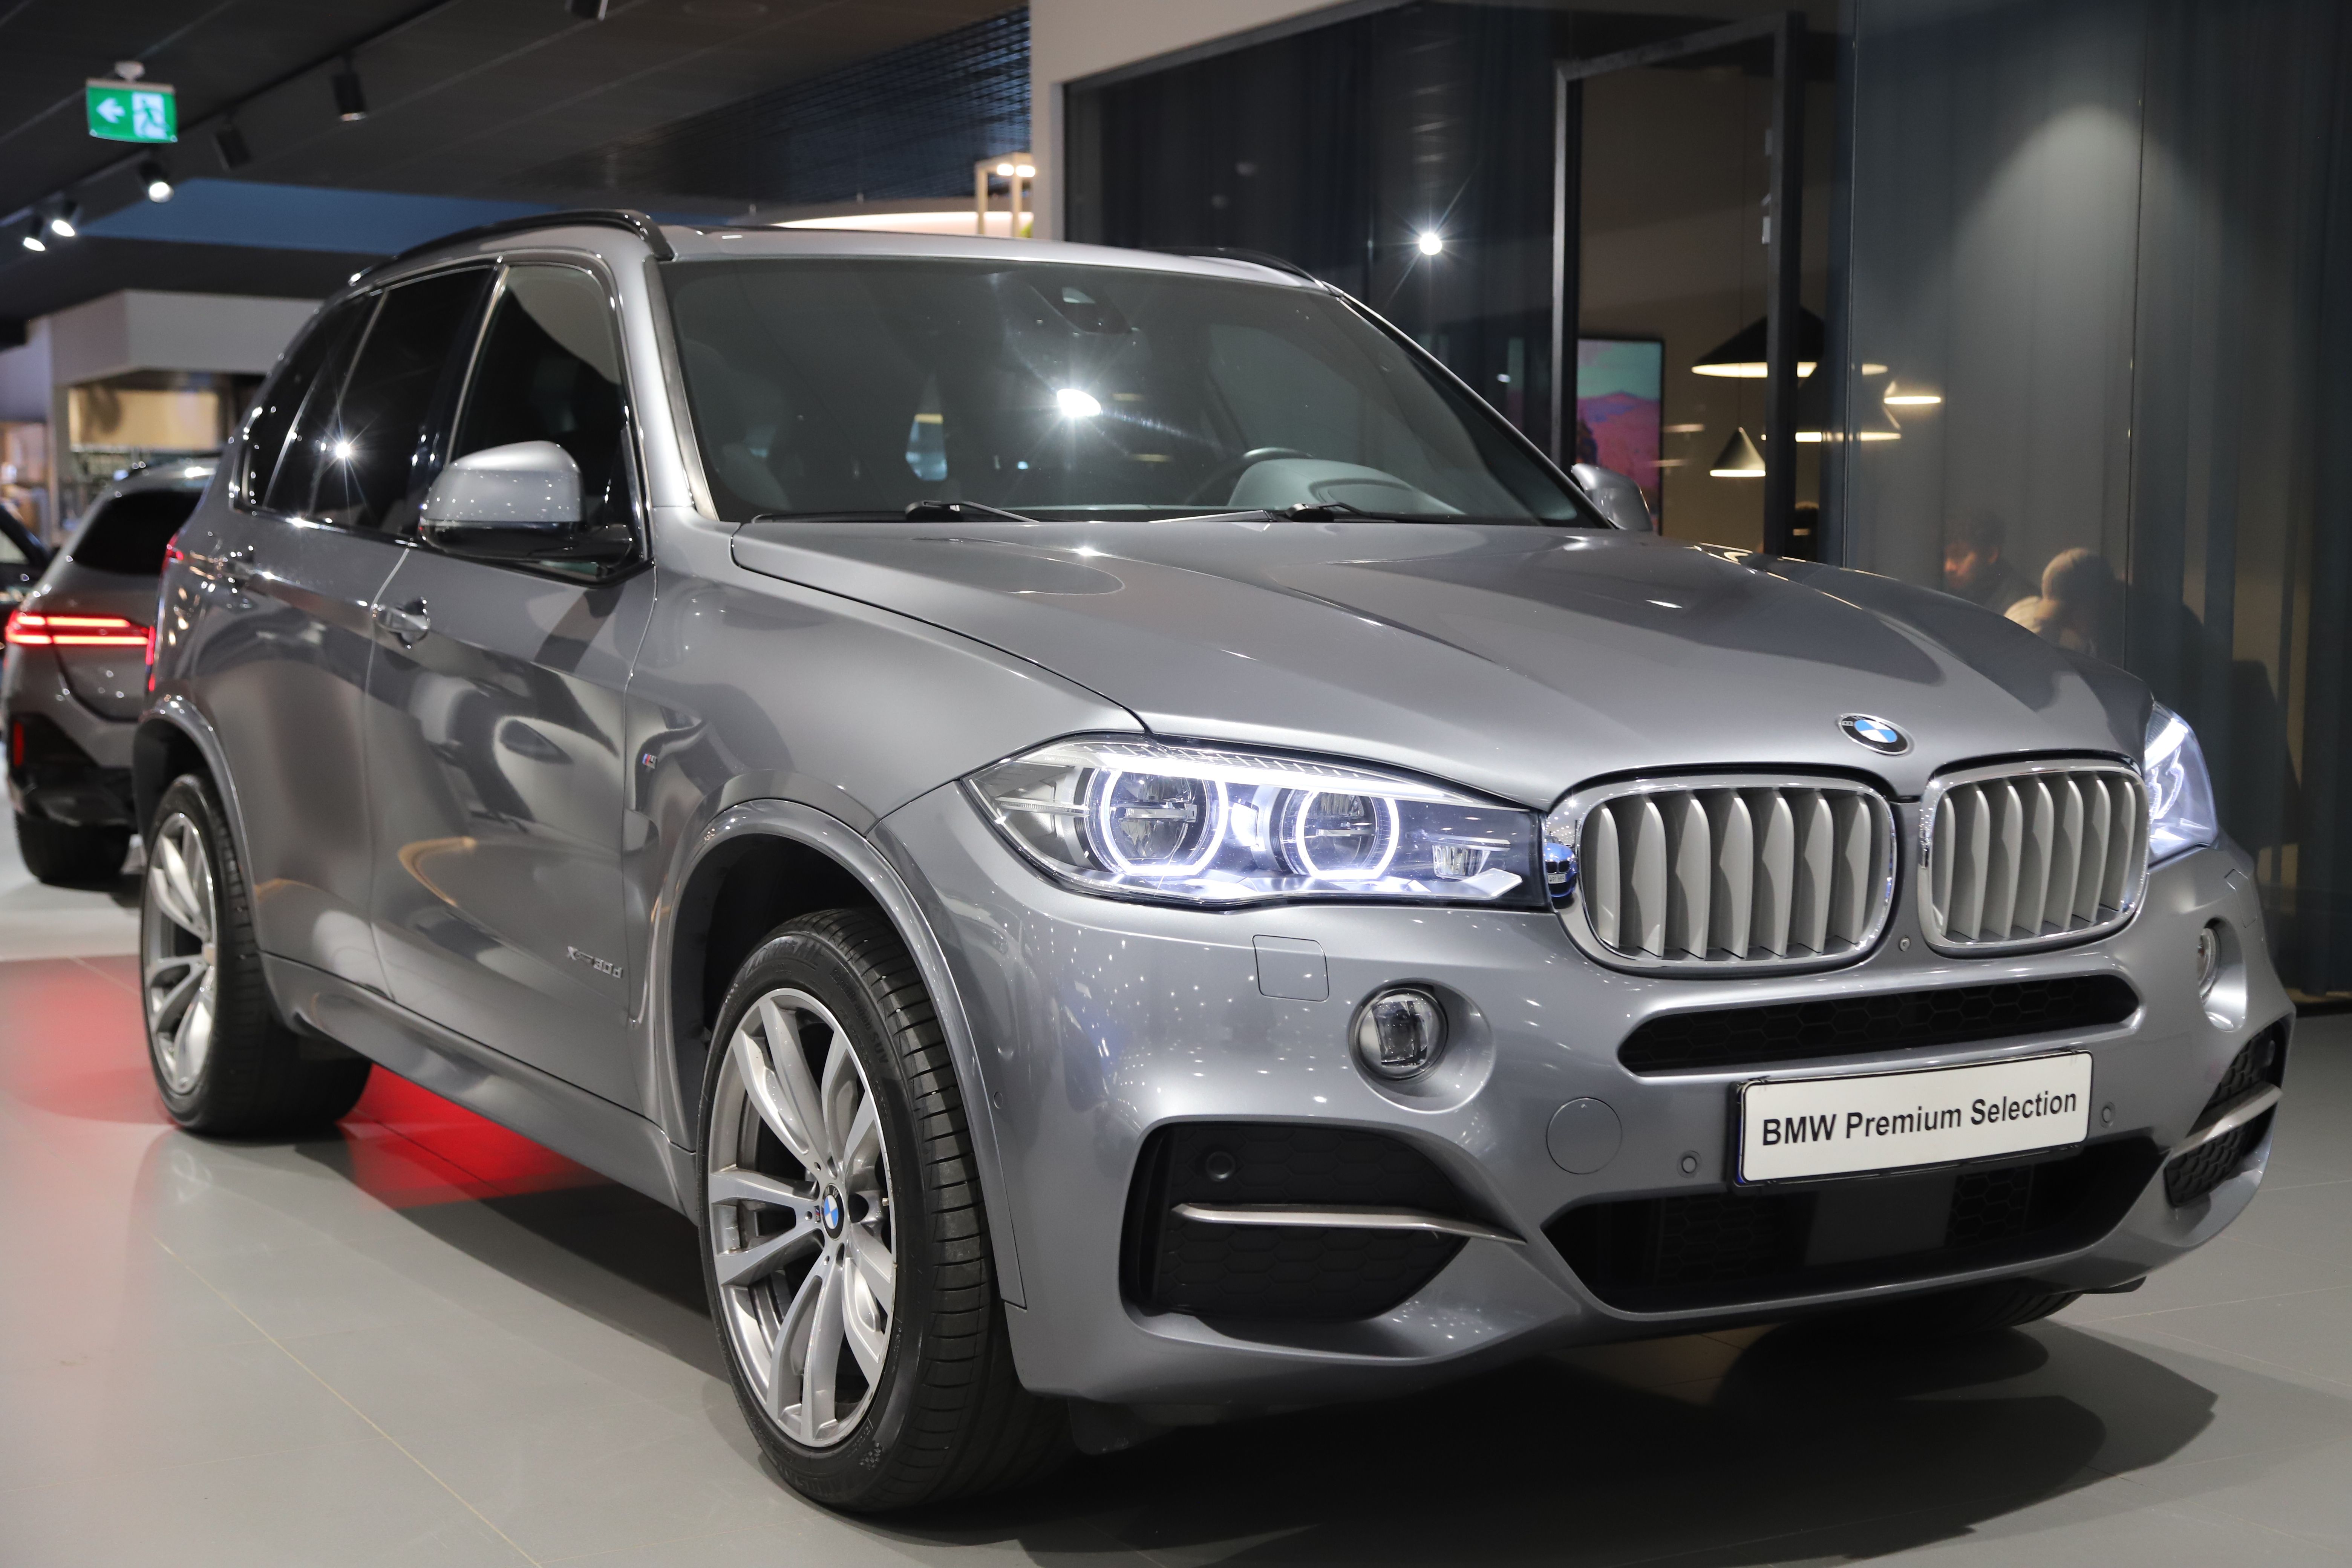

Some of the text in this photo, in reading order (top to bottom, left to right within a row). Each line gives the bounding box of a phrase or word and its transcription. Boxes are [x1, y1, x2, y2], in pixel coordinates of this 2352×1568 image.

[870, 1032, 889, 1063] SUV
[1763, 1091, 2076, 1145] BMW Premium Selection
